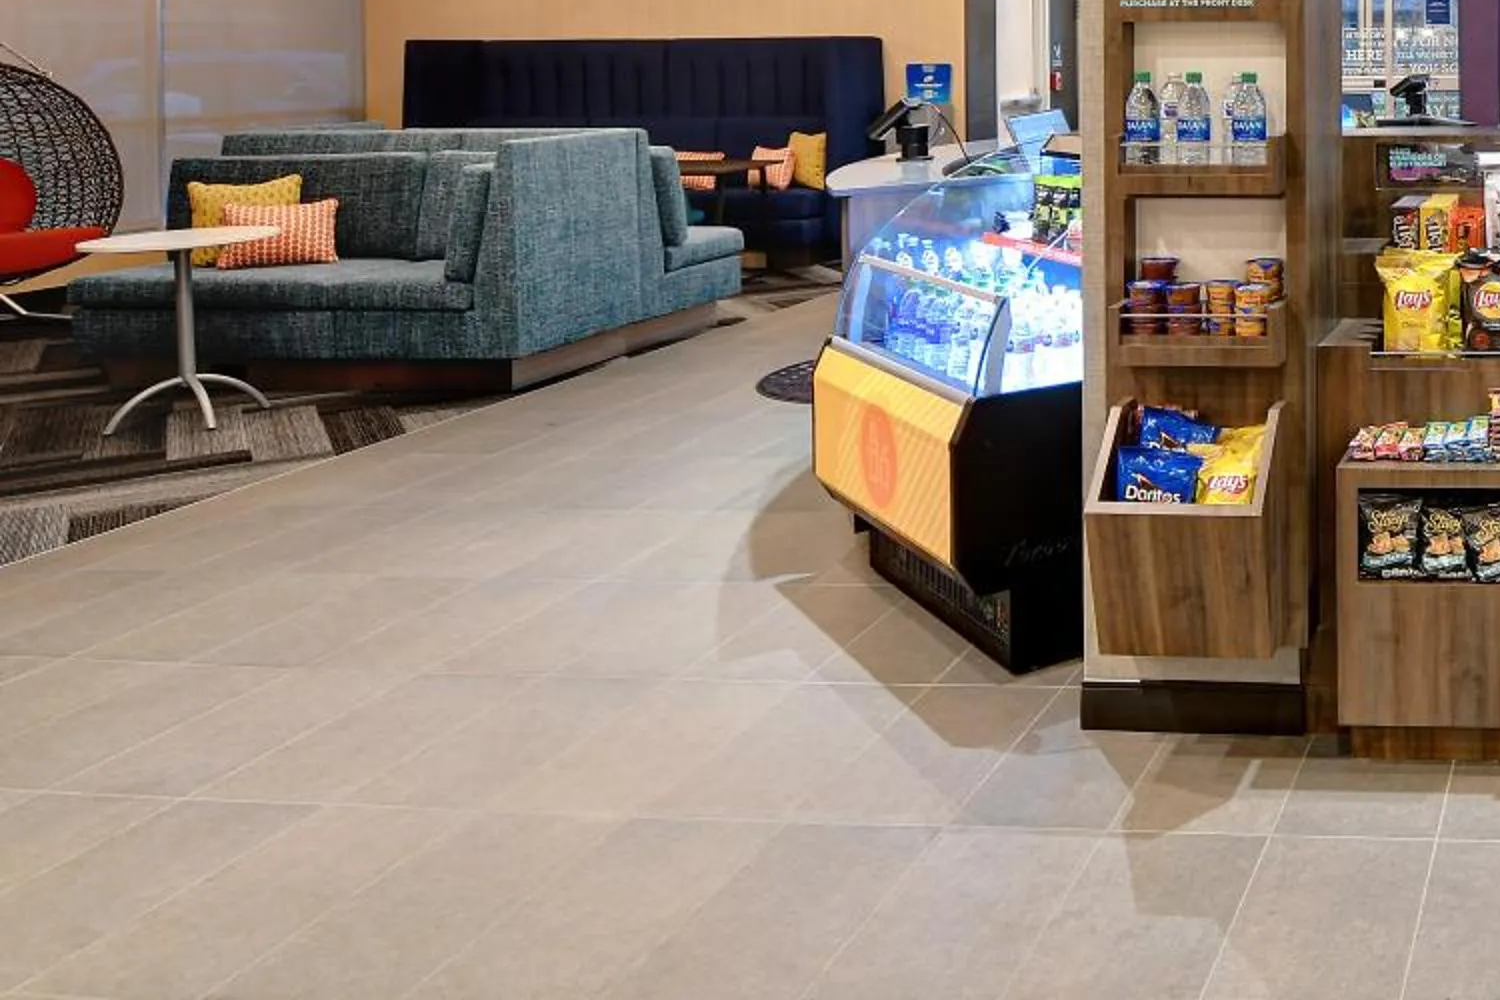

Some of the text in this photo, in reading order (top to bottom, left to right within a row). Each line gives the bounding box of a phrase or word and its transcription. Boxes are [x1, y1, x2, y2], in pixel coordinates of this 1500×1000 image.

[1397, 289, 1432, 310] Lay's
[1208, 475, 1249, 492] Lay's
[1125, 484, 1181, 504] Doritos
